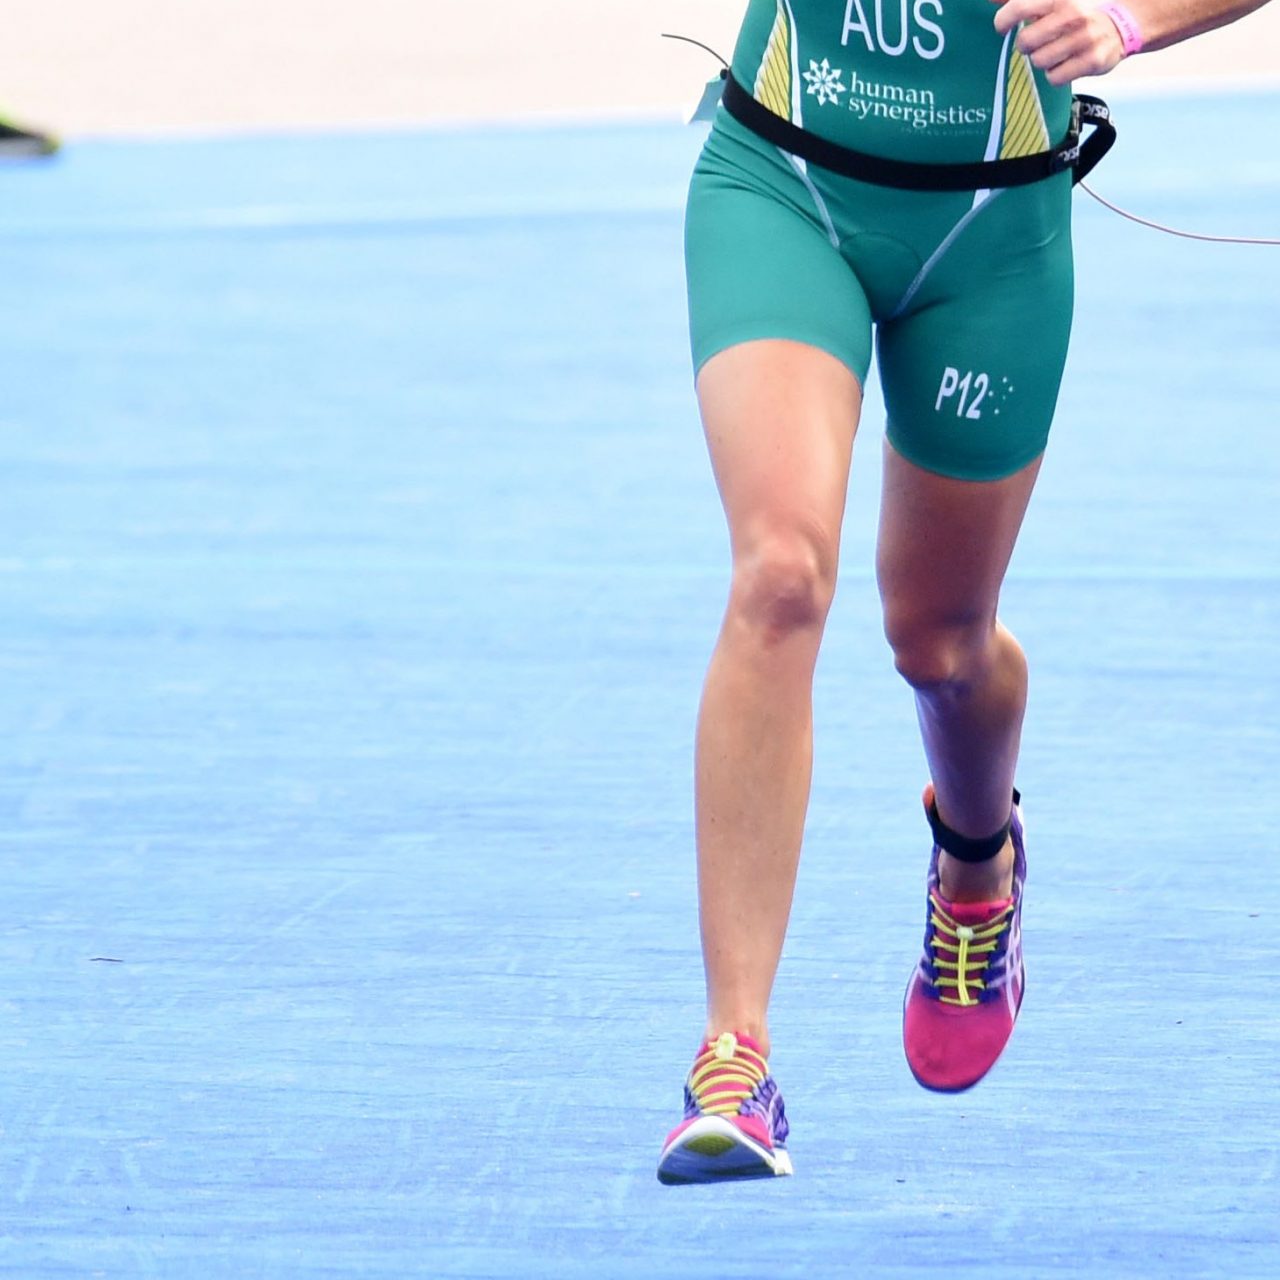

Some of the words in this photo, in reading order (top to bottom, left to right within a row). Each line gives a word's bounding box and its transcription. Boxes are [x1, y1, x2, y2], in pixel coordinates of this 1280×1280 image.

[851, 71, 935, 107] human
[848, 97, 987, 128] synergistics
[934, 366, 989, 420] P12
